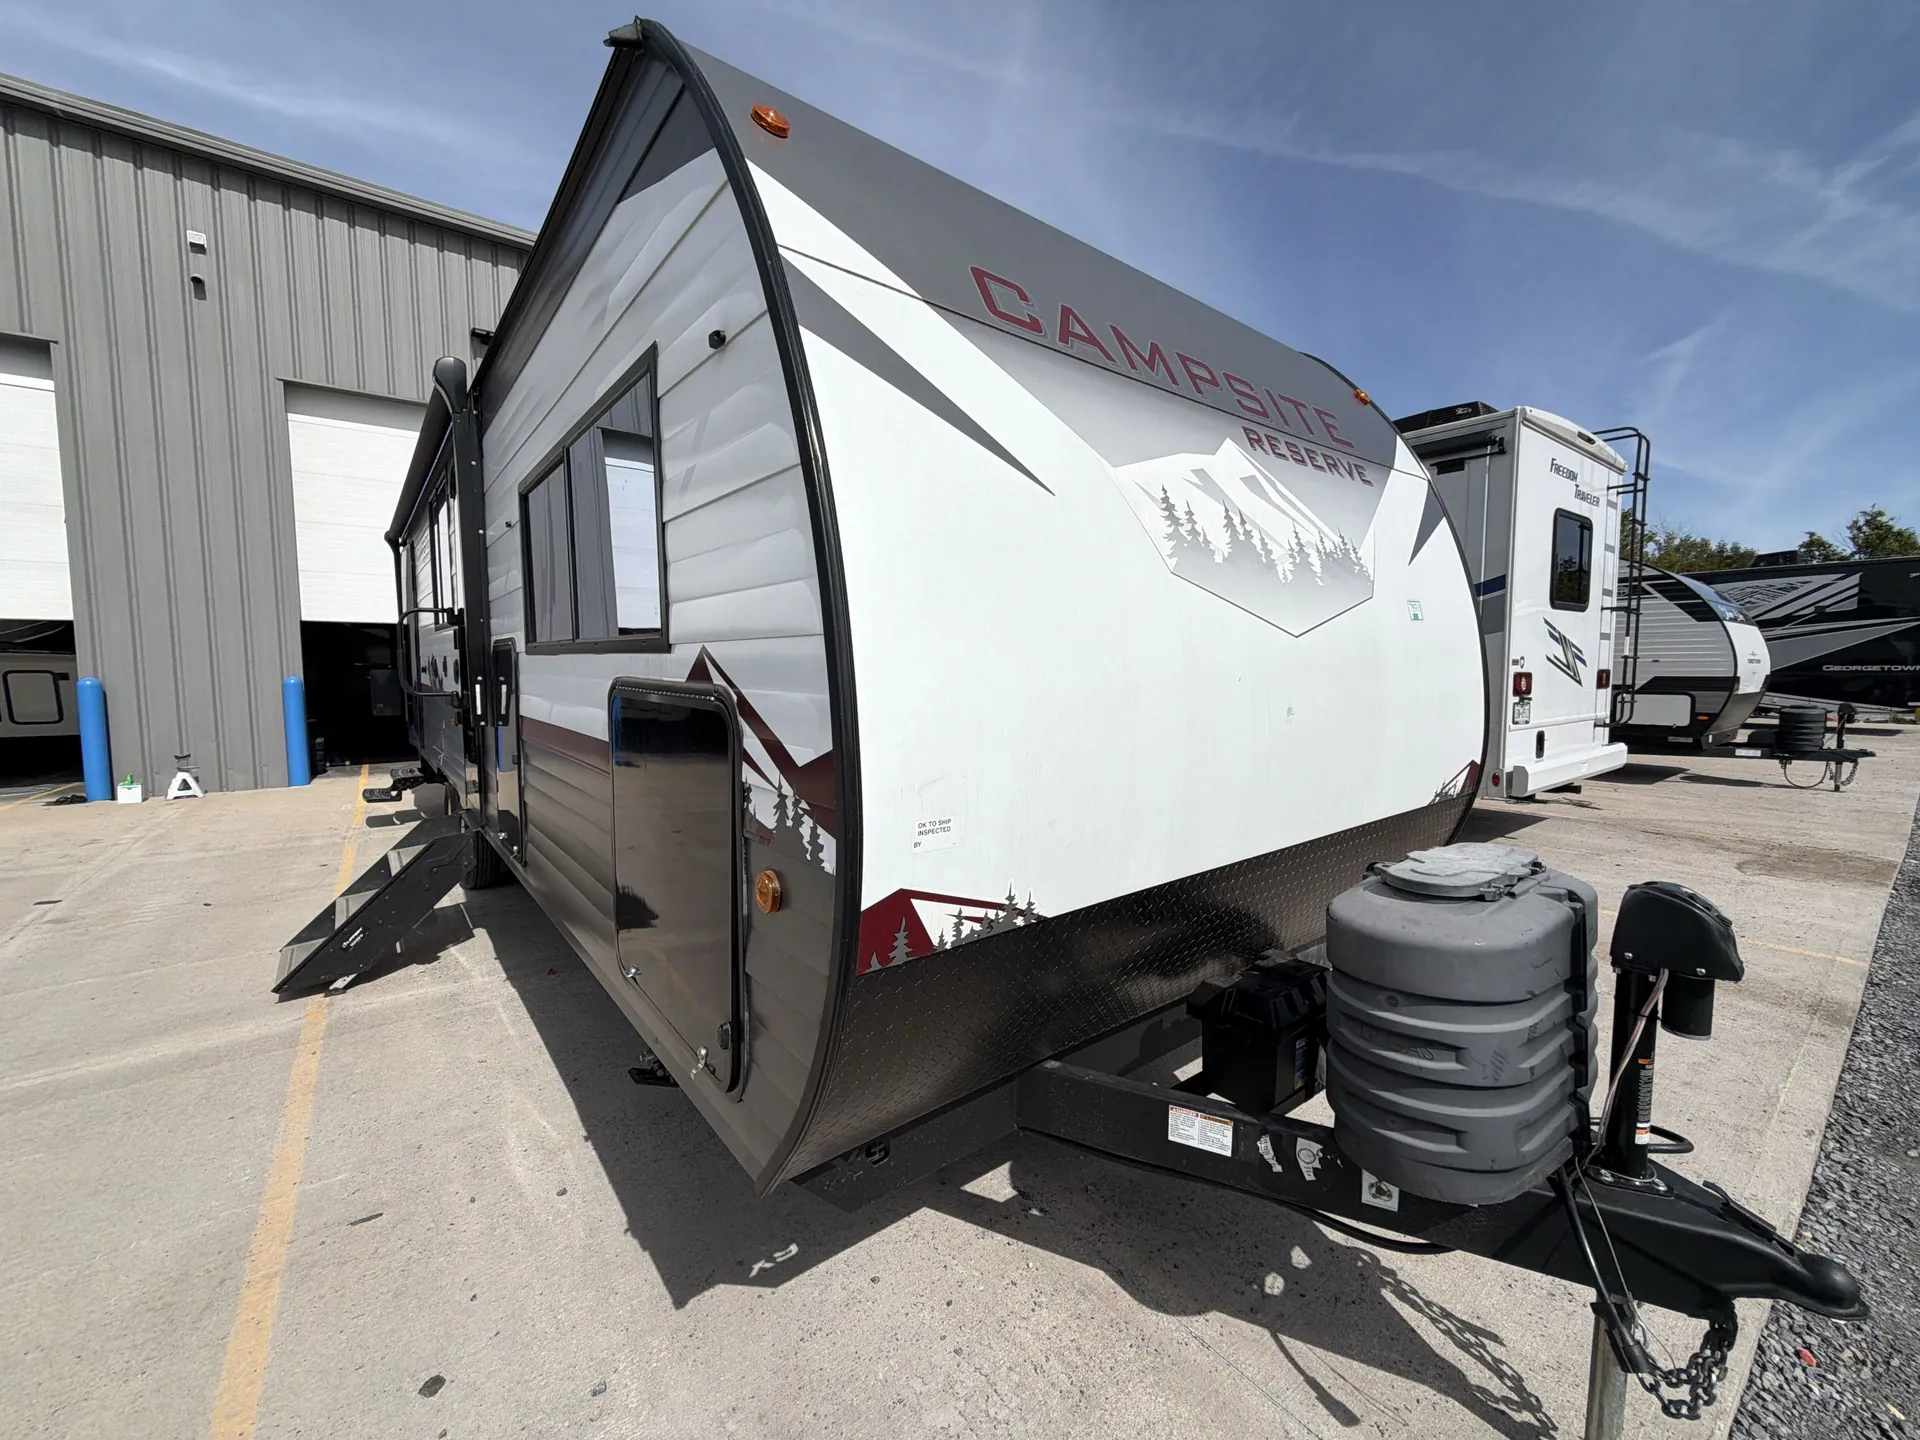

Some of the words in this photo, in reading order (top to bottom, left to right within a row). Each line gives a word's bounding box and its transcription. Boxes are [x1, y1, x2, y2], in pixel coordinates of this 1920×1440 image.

[970, 265, 1356, 449] CAMPSITE
[1242, 426, 1374, 487] RESERVE
[1549, 457, 1578, 482] FREEDOM
[1574, 483, 1600, 507] TRAVELER
[917, 825, 951, 836] INSPECTED
[928, 820, 937, 828] TO
[938, 818, 952, 826] SHIP
